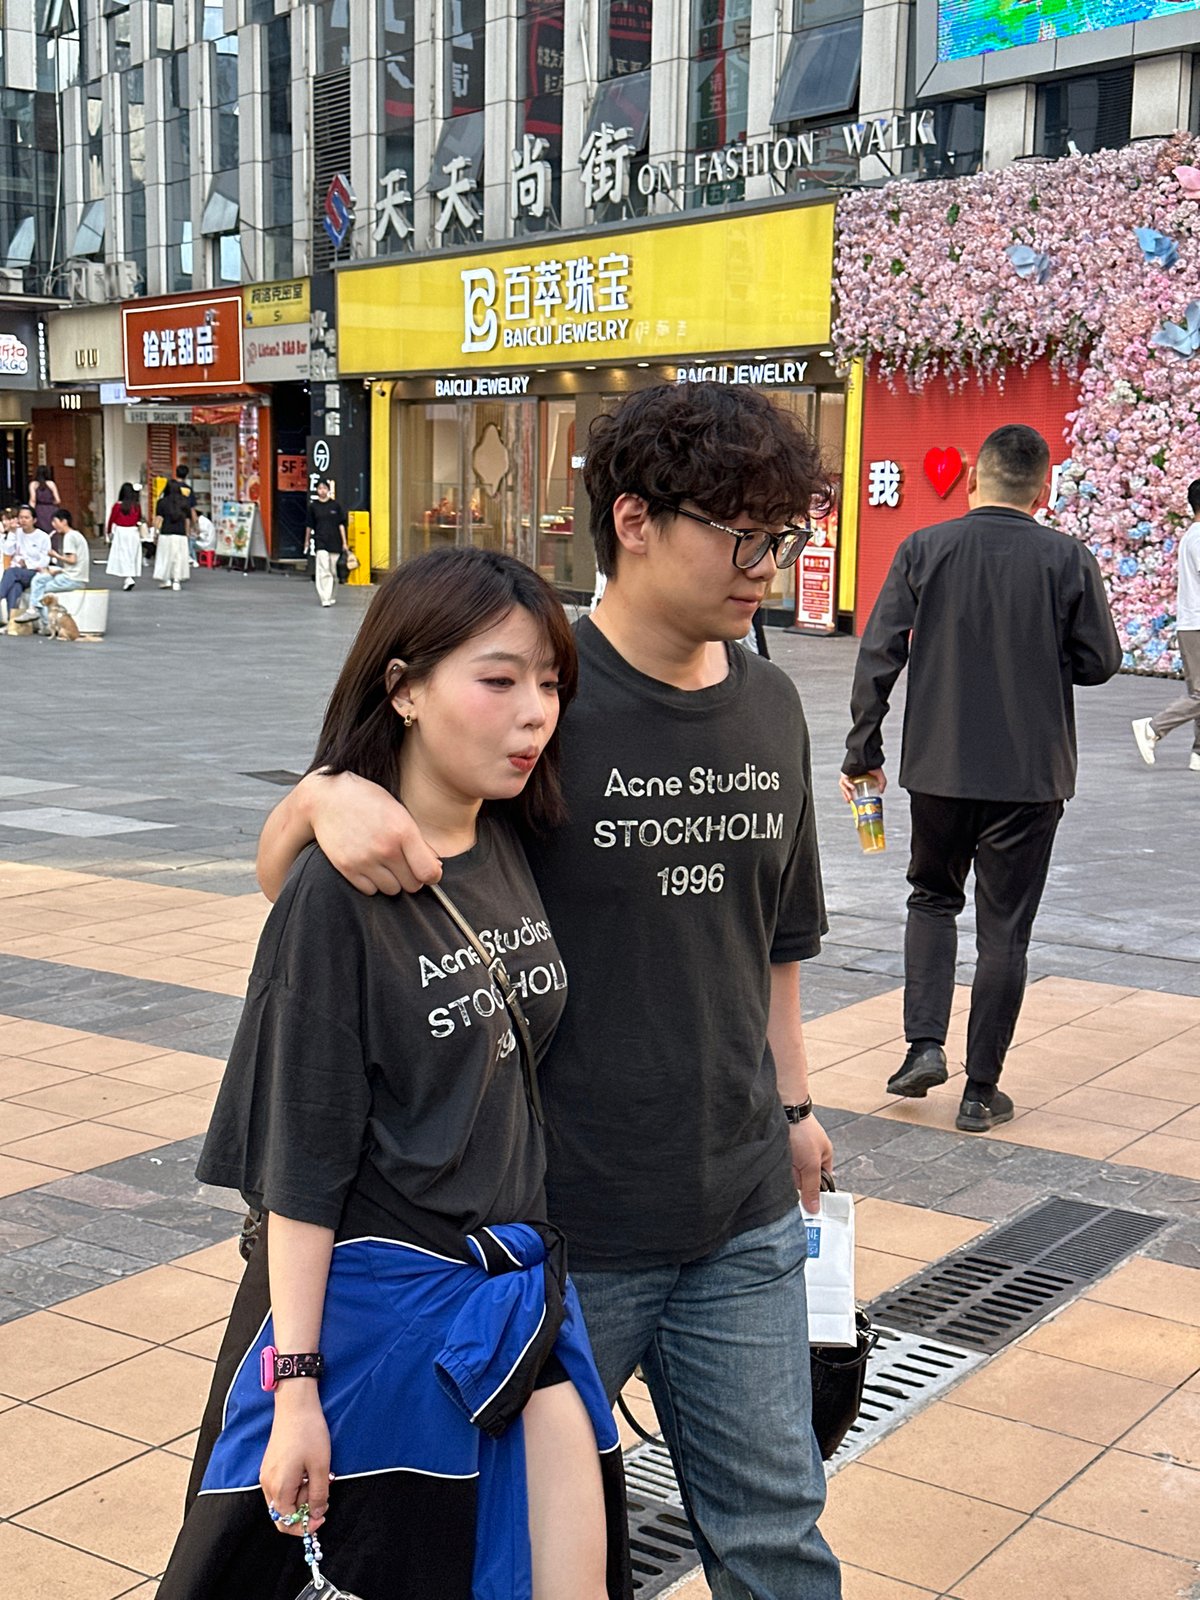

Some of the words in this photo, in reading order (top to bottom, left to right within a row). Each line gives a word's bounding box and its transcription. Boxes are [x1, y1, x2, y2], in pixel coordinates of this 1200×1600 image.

[637, 163, 675, 195] ON
[694, 132, 814, 185] FASHION
[842, 109, 937, 156] WALK
[374, 122, 635, 242] 天天尚街
[504, 253, 630, 321] 百萃珠宝
[143, 325, 214, 368] 拾光甜品
[504, 324, 551, 348] BAICUI
[553, 319, 630, 345] JEWELRY
[435, 379, 473, 397] BAICUI
[473, 376, 530, 396] JEWELRY
[676, 366, 728, 385] BAICUI
[729, 361, 808, 385] JEWELRY
[868, 459, 901, 507] 我
[603, 767, 683, 797] Acne
[688, 762, 780, 795] Studios
[593, 812, 784, 848] STOCKHOLM
[657, 862, 726, 896] 1996
